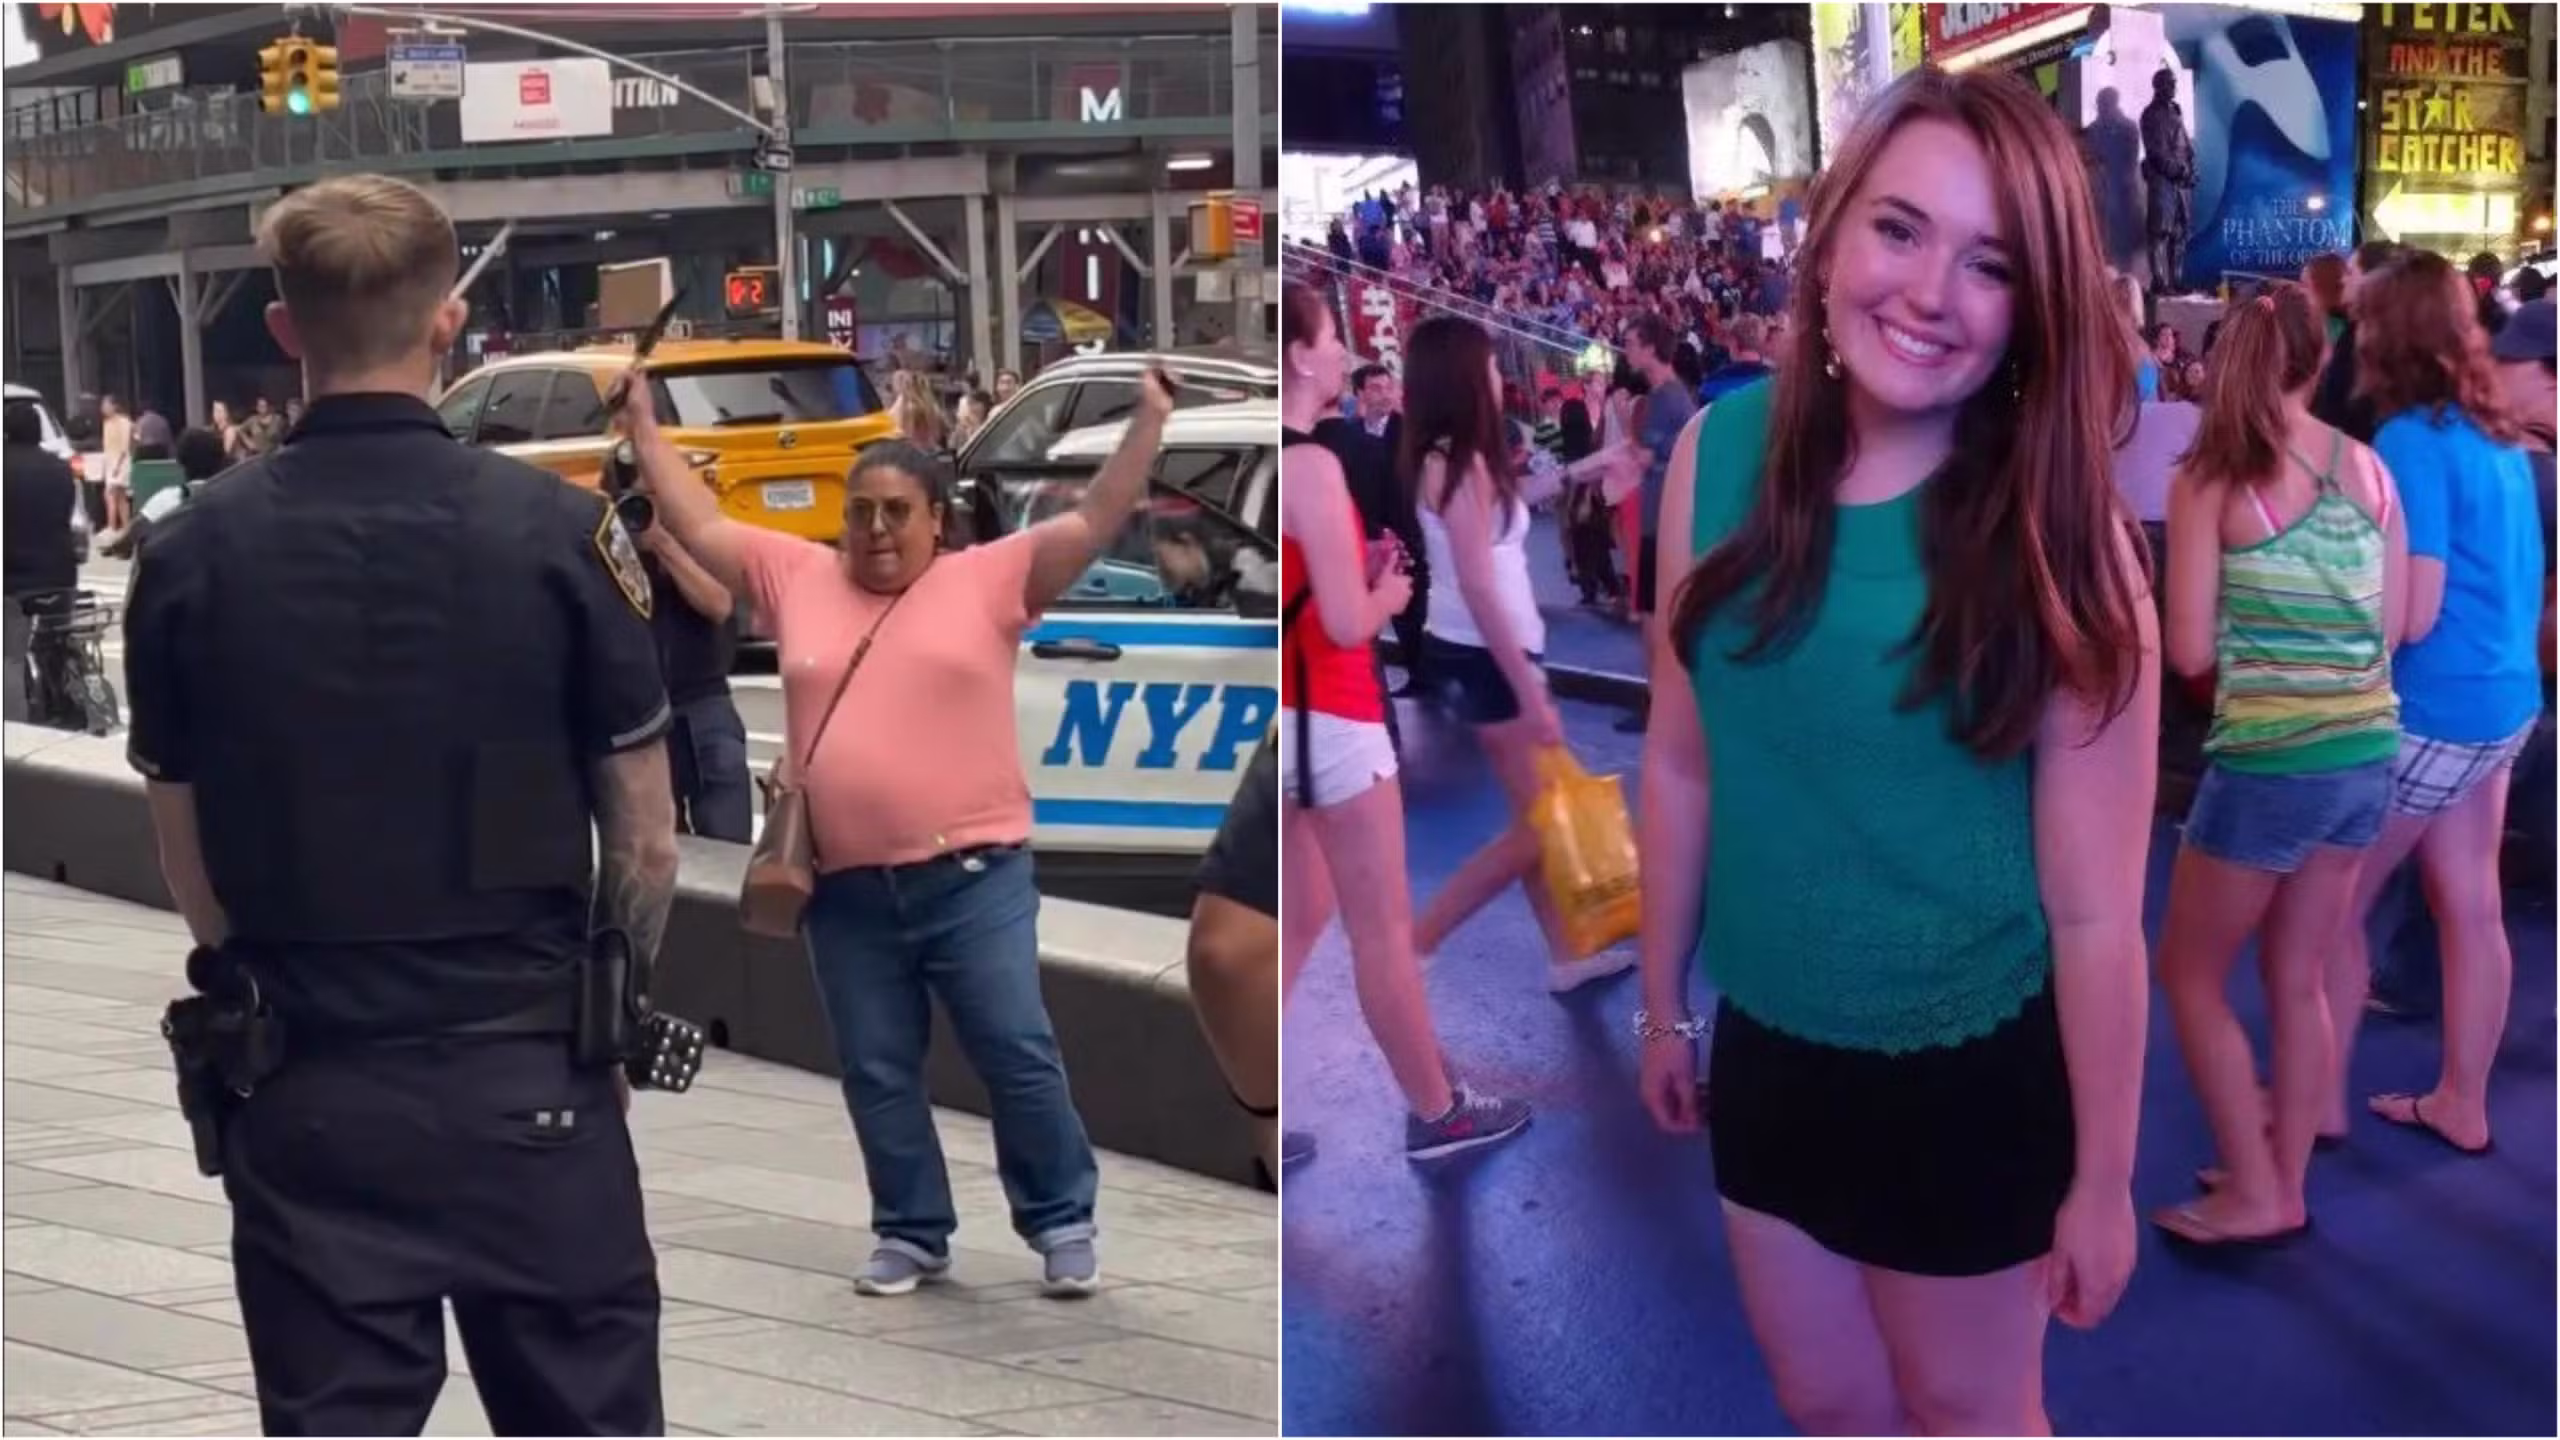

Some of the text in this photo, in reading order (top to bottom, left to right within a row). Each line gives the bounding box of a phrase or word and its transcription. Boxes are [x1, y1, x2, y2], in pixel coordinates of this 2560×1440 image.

[2391, 44, 2501, 75] AND THE
[2379, 133, 2519, 174] CATCHER
[2272, 198, 2299, 216] THE
[2223, 217, 2349, 248] PHANTOM
[1042, 679, 1279, 771] NYP
